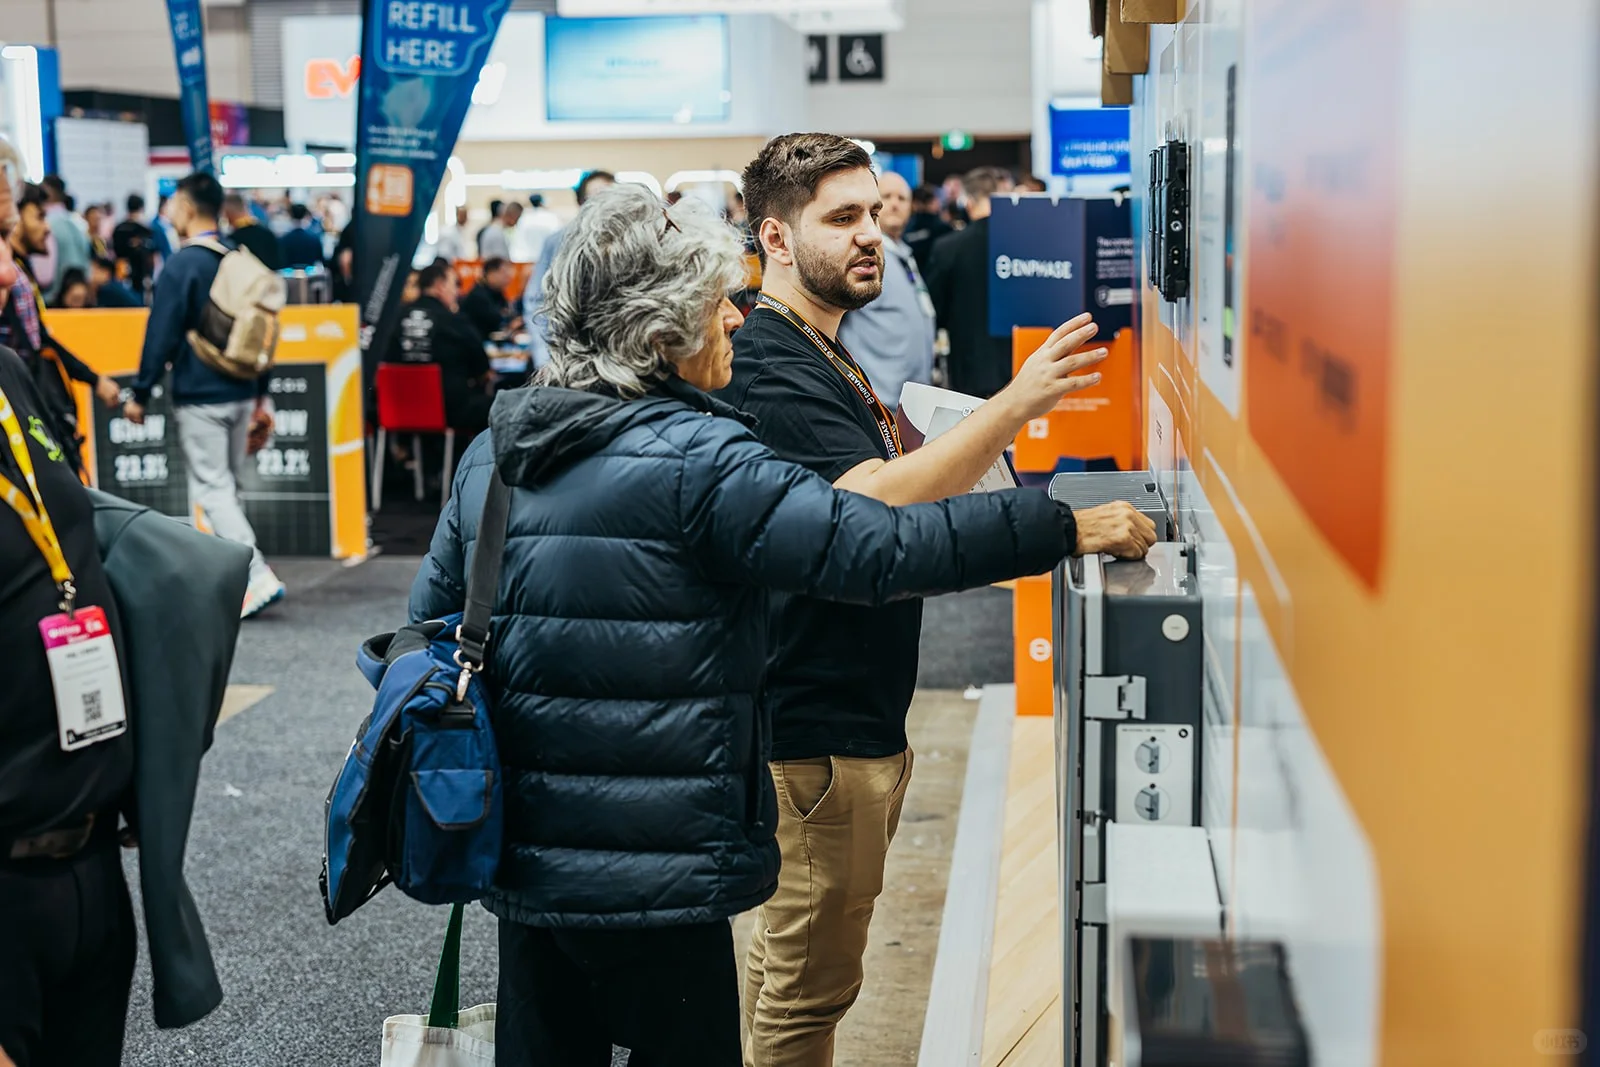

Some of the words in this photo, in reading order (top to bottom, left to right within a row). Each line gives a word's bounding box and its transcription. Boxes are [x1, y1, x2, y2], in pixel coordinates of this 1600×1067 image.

[388, 1, 476, 32] REFILL
[386, 38, 455, 67] HERE
[1011, 258, 1073, 279] ENPHASE
[803, 323, 828, 352] ENPHASE
[847, 371, 871, 398] ENPHASE
[880, 419, 896, 452] ENPHASE
